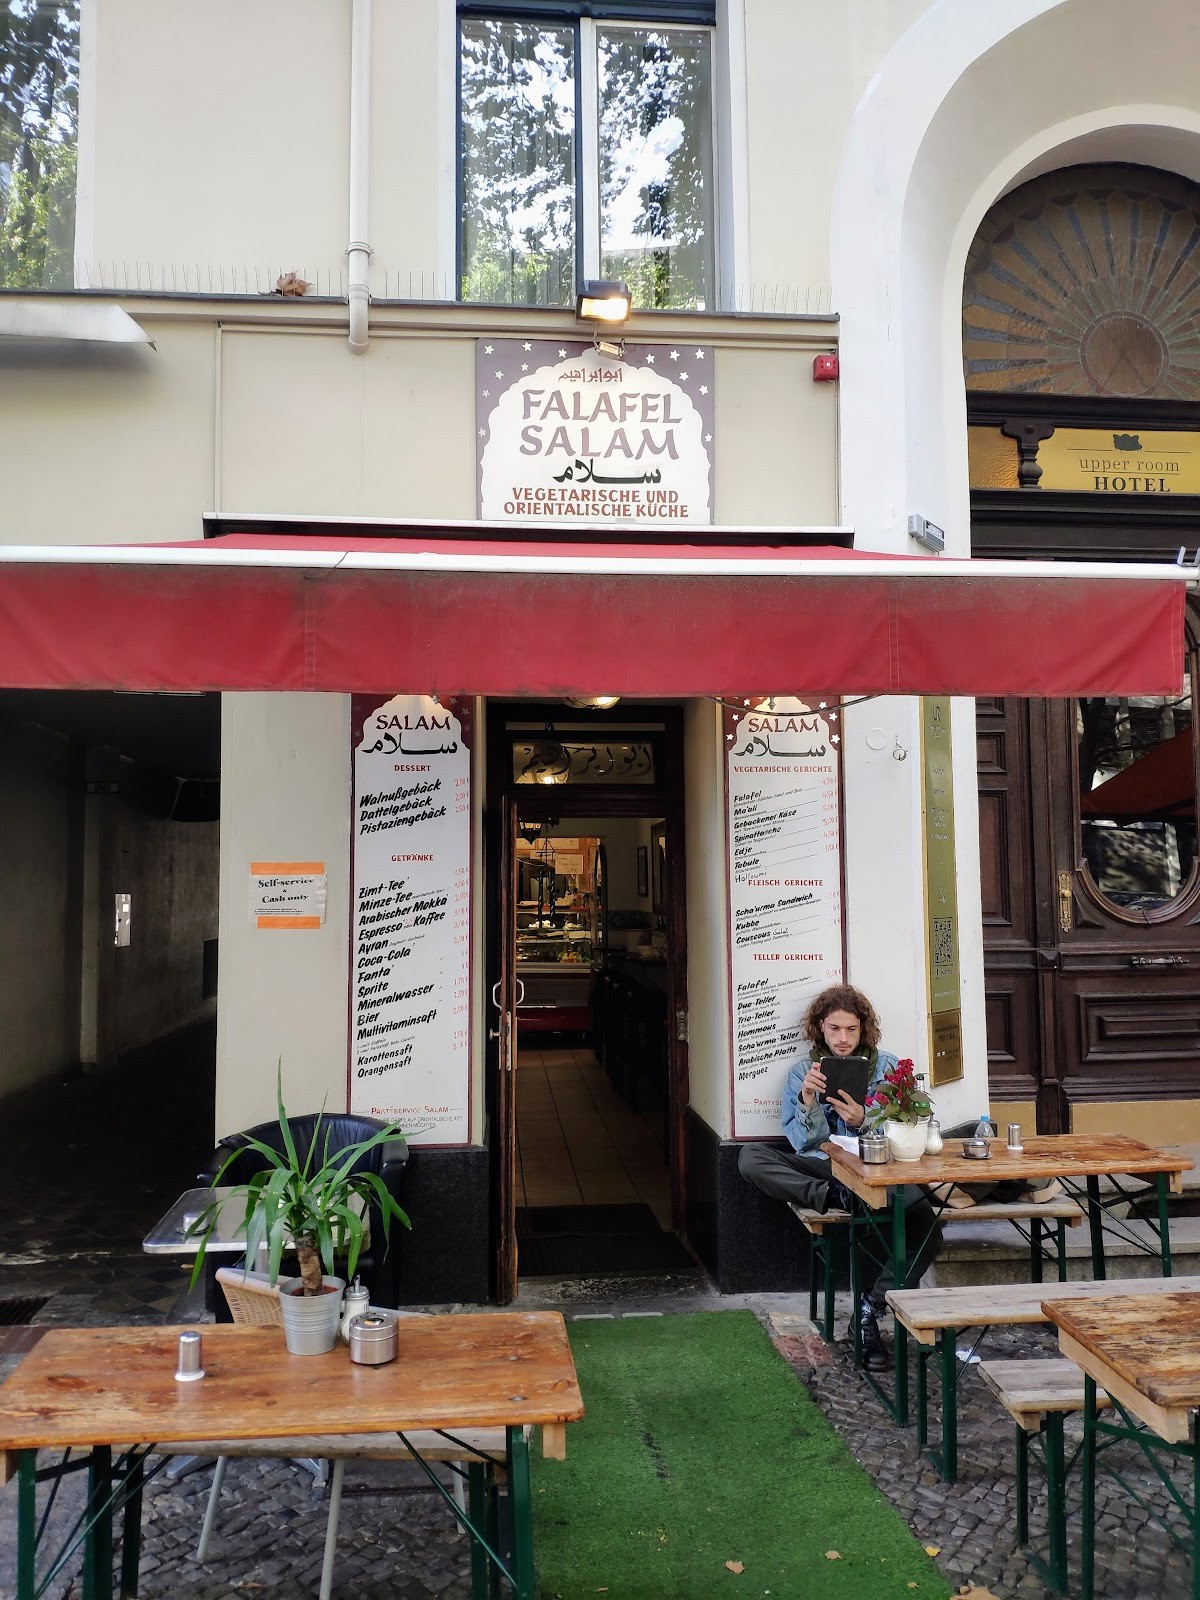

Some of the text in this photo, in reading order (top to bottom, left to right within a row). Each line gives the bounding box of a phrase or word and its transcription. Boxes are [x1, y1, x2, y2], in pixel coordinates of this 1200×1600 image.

[522, 389, 682, 424] FALAFEL
[519, 424, 680, 460] SALAM
[552, 458, 662, 484] سلام
[1079, 458, 1180, 473] upper room
[1094, 476, 1171, 493] HOTEL
[512, 487, 679, 504] VEGETARISCHE UND
[503, 501, 689, 518] ORIENTALISCHE KÜCHE
[376, 714, 451, 731] SALAM
[748, 718, 819, 733] SALAM
[361, 731, 458, 755] سلام
[733, 734, 827, 757] سلام
[734, 790, 762, 803] Falafel
[360, 796, 433, 822] Dattelgebäck
[360, 805, 447, 836] Pistaziengebäck
[734, 813, 777, 829] Gebackener
[778, 809, 797, 819] Käse
[391, 853, 434, 862] GETRÄNKE
[734, 846, 753, 856] Edje
[734, 857, 760, 870] Tabule
[258, 877, 314, 889] Self-service
[358, 880, 405, 899] Zimt-Tee
[262, 895, 285, 904] Cash
[358, 891, 413, 912] Minze-Tee
[777, 892, 813, 907] Sandwich
[358, 896, 448, 926] Arabischer Mokka
[358, 921, 403, 941] Espresso
[412, 911, 446, 927] Kaffee
[736, 920, 760, 931] Kubbe
[736, 931, 771, 944] Couscous
[358, 939, 389, 955] Ayran
[358, 947, 411, 969] Coca-Cola
[357, 967, 391, 984] Fanta
[357, 981, 389, 999] Sprite
[737, 978, 769, 992] Falafel
[357, 983, 435, 1012] Mineralwasser
[737, 995, 777, 1010] Duo-Teller
[357, 1011, 381, 1027] Bier
[357, 1009, 438, 1041] Multivitaminsaft
[738, 1009, 775, 1024] Trio-Teller
[738, 1023, 776, 1039] Hommous
[357, 1043, 413, 1066] Karottensaft
[738, 1052, 773, 1066] Arabische
[774, 1046, 797, 1057] Platte
[357, 1056, 412, 1078] Orangensaft
[738, 1066, 769, 1081] Merguez
